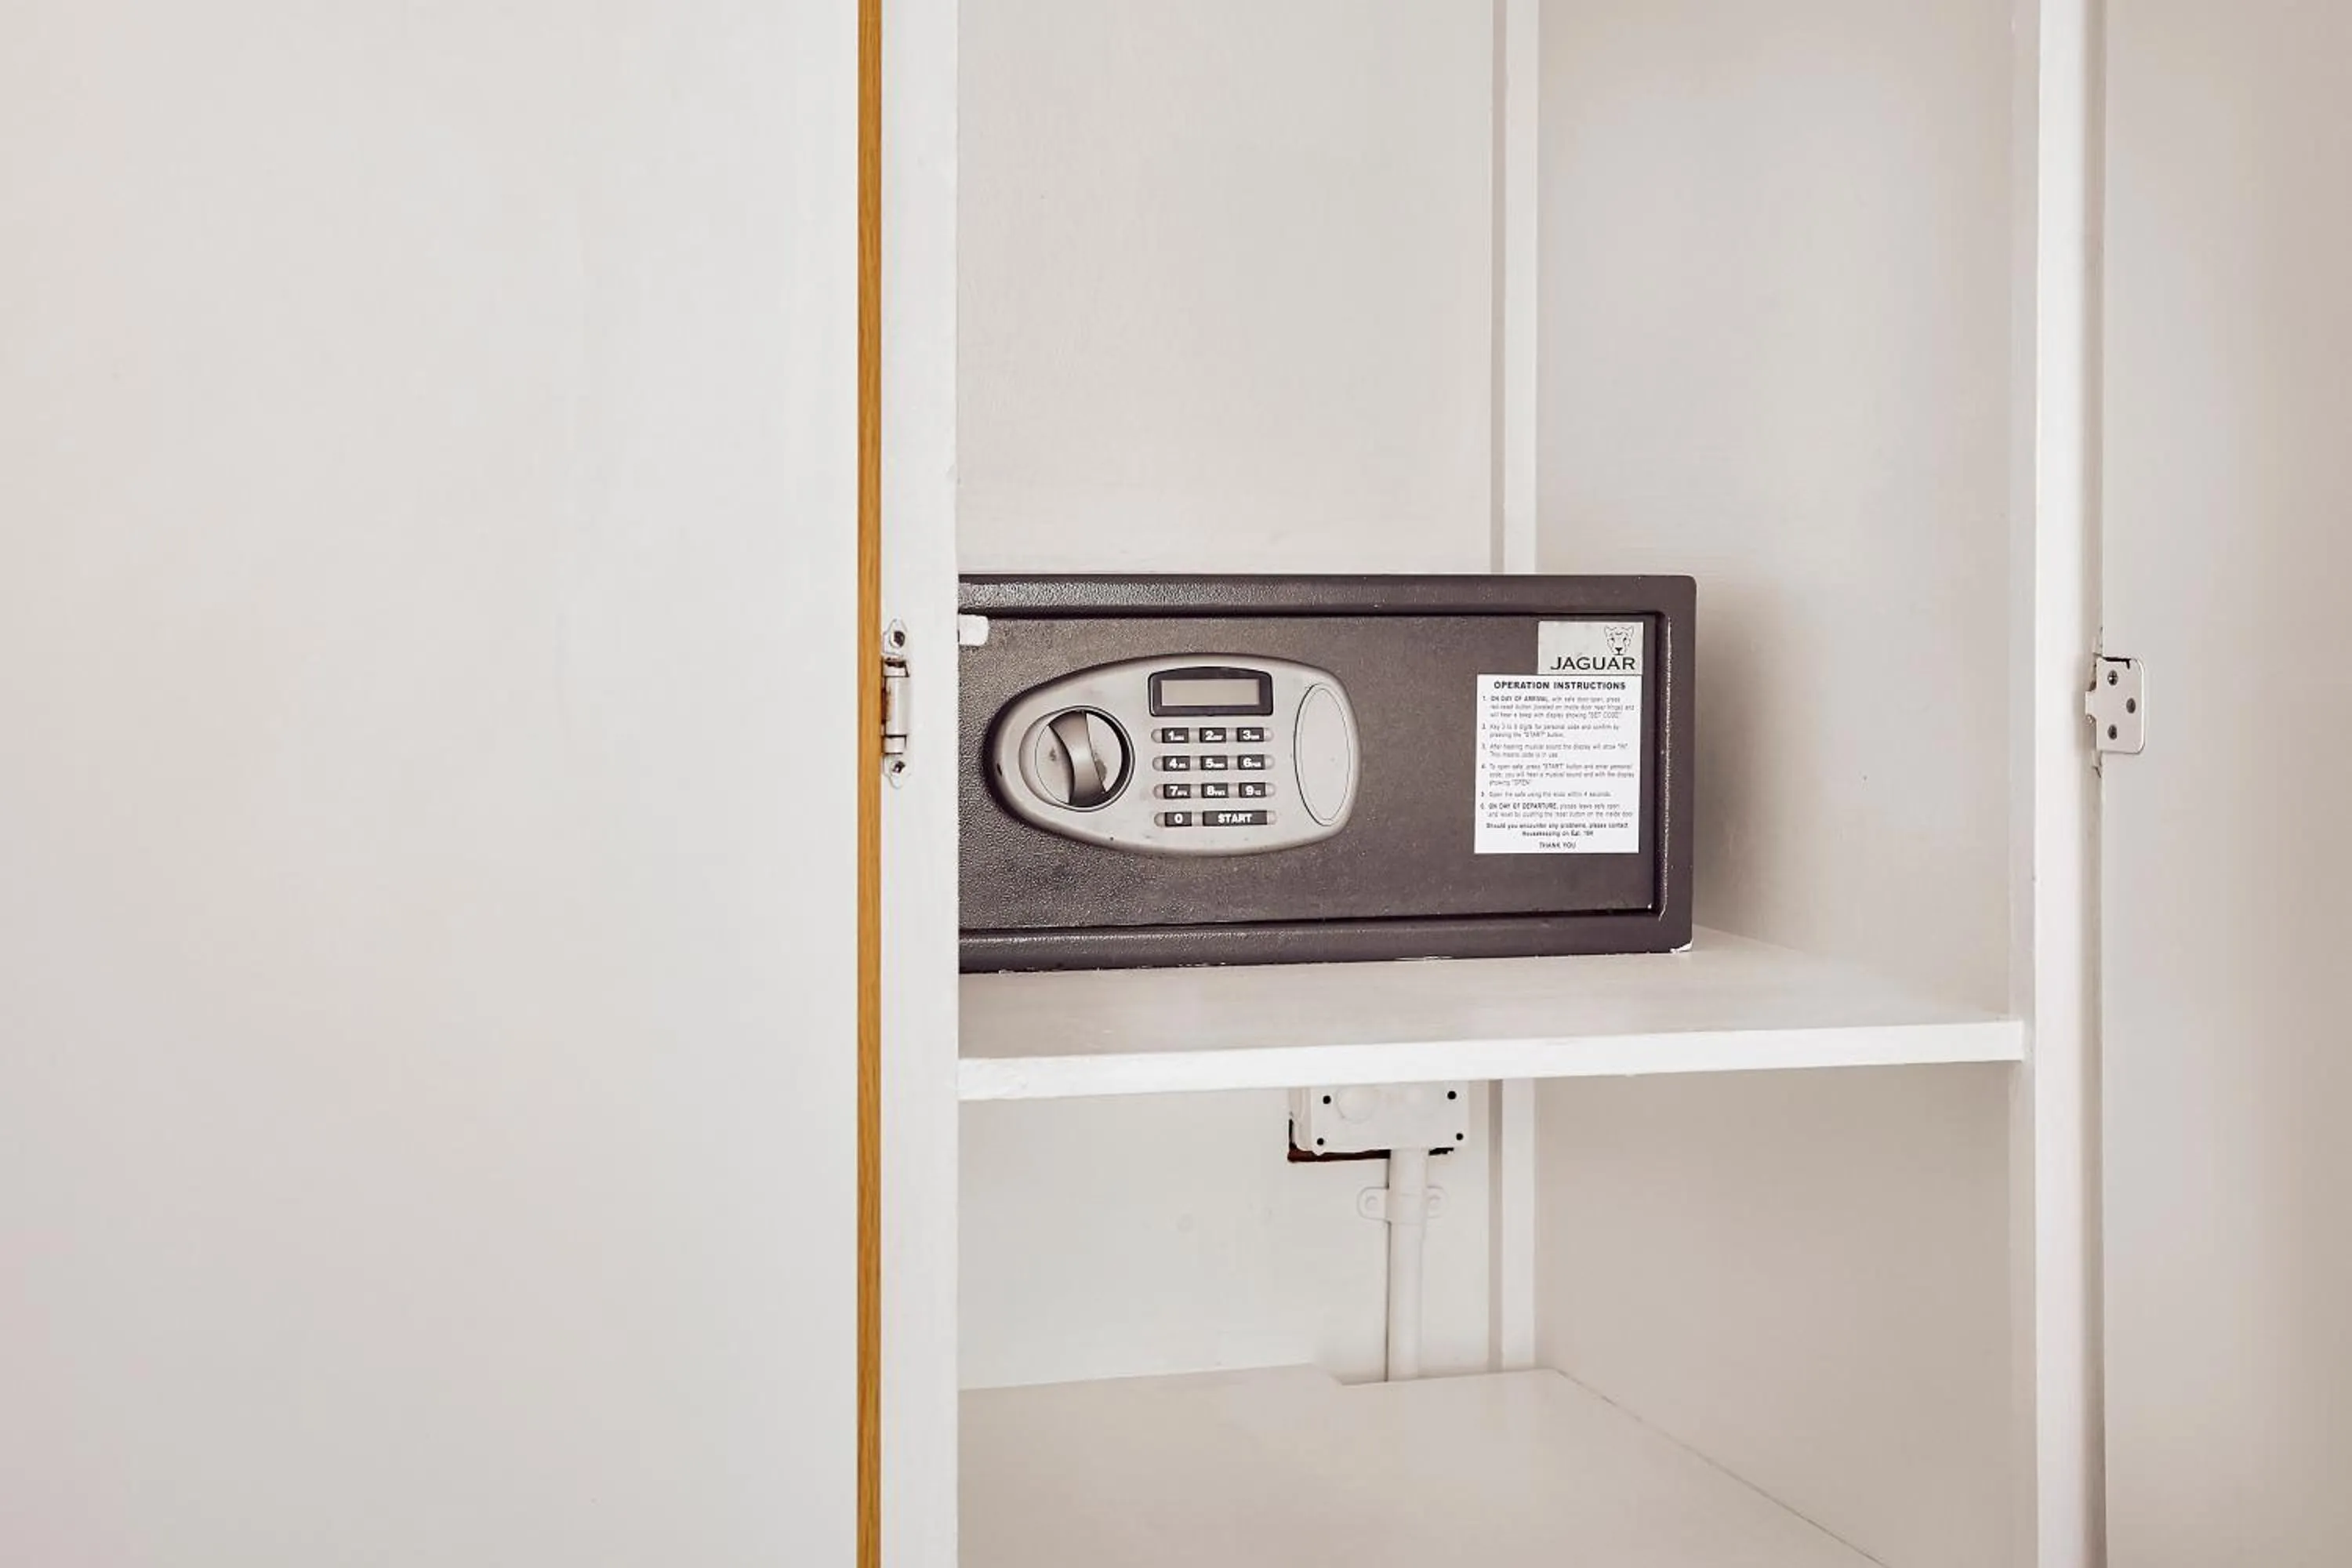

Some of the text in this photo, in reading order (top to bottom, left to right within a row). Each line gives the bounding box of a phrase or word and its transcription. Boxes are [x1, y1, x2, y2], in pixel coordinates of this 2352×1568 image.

[1550, 657, 1635, 670] JAGUAR
[1494, 681, 1626, 690] OPERATION INSTRUCTIONS
[1168, 730, 1174, 741] 1
[1205, 730, 1214, 741] 2
[1243, 730, 1251, 740] 3
[1169, 758, 1177, 768] 4
[1205, 758, 1213, 768] 5
[1243, 757, 1251, 768] 6
[1170, 786, 1178, 796] 7
[1207, 786, 1214, 796] 8
[1245, 785, 1254, 796] 9
[1218, 813, 1253, 824] START
